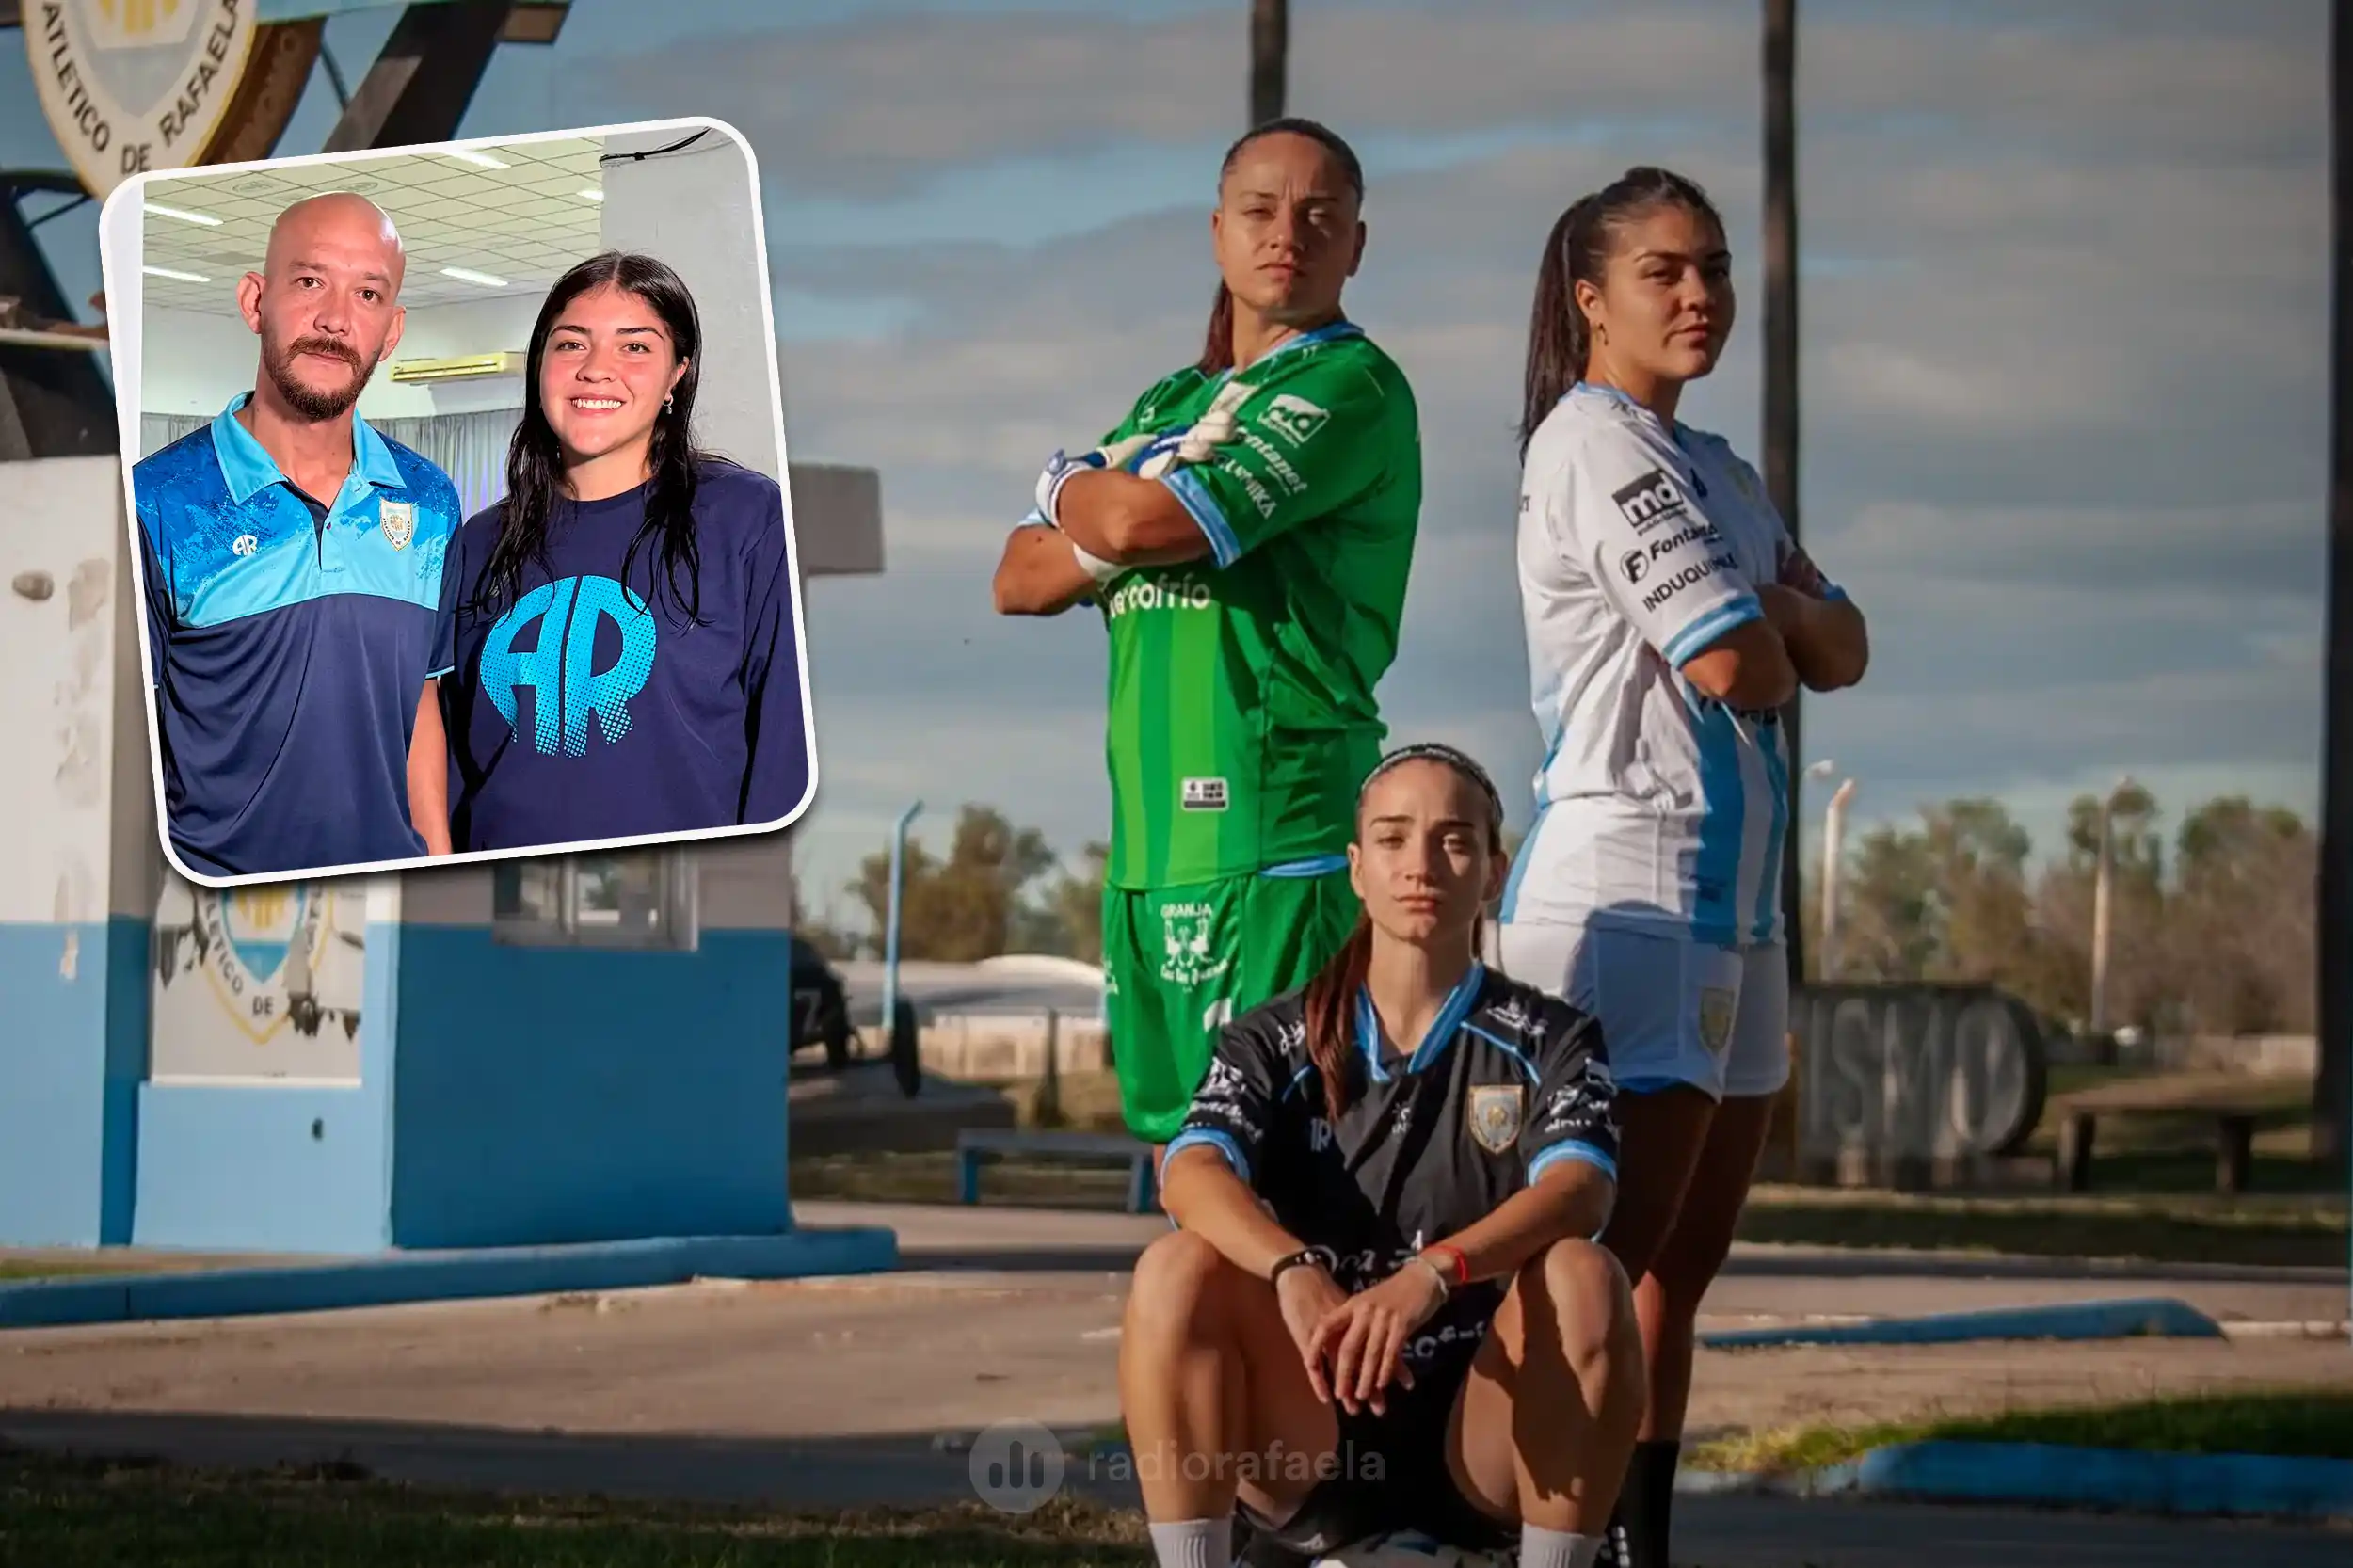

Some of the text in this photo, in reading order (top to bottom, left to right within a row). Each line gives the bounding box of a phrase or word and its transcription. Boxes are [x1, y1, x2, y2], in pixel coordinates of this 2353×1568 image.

[42, 0, 240, 175] ATLETICO DE RAFAELA
[1621, 472, 1684, 528] md
[480, 575, 657, 757] AR
[252, 995, 275, 1016] DE
